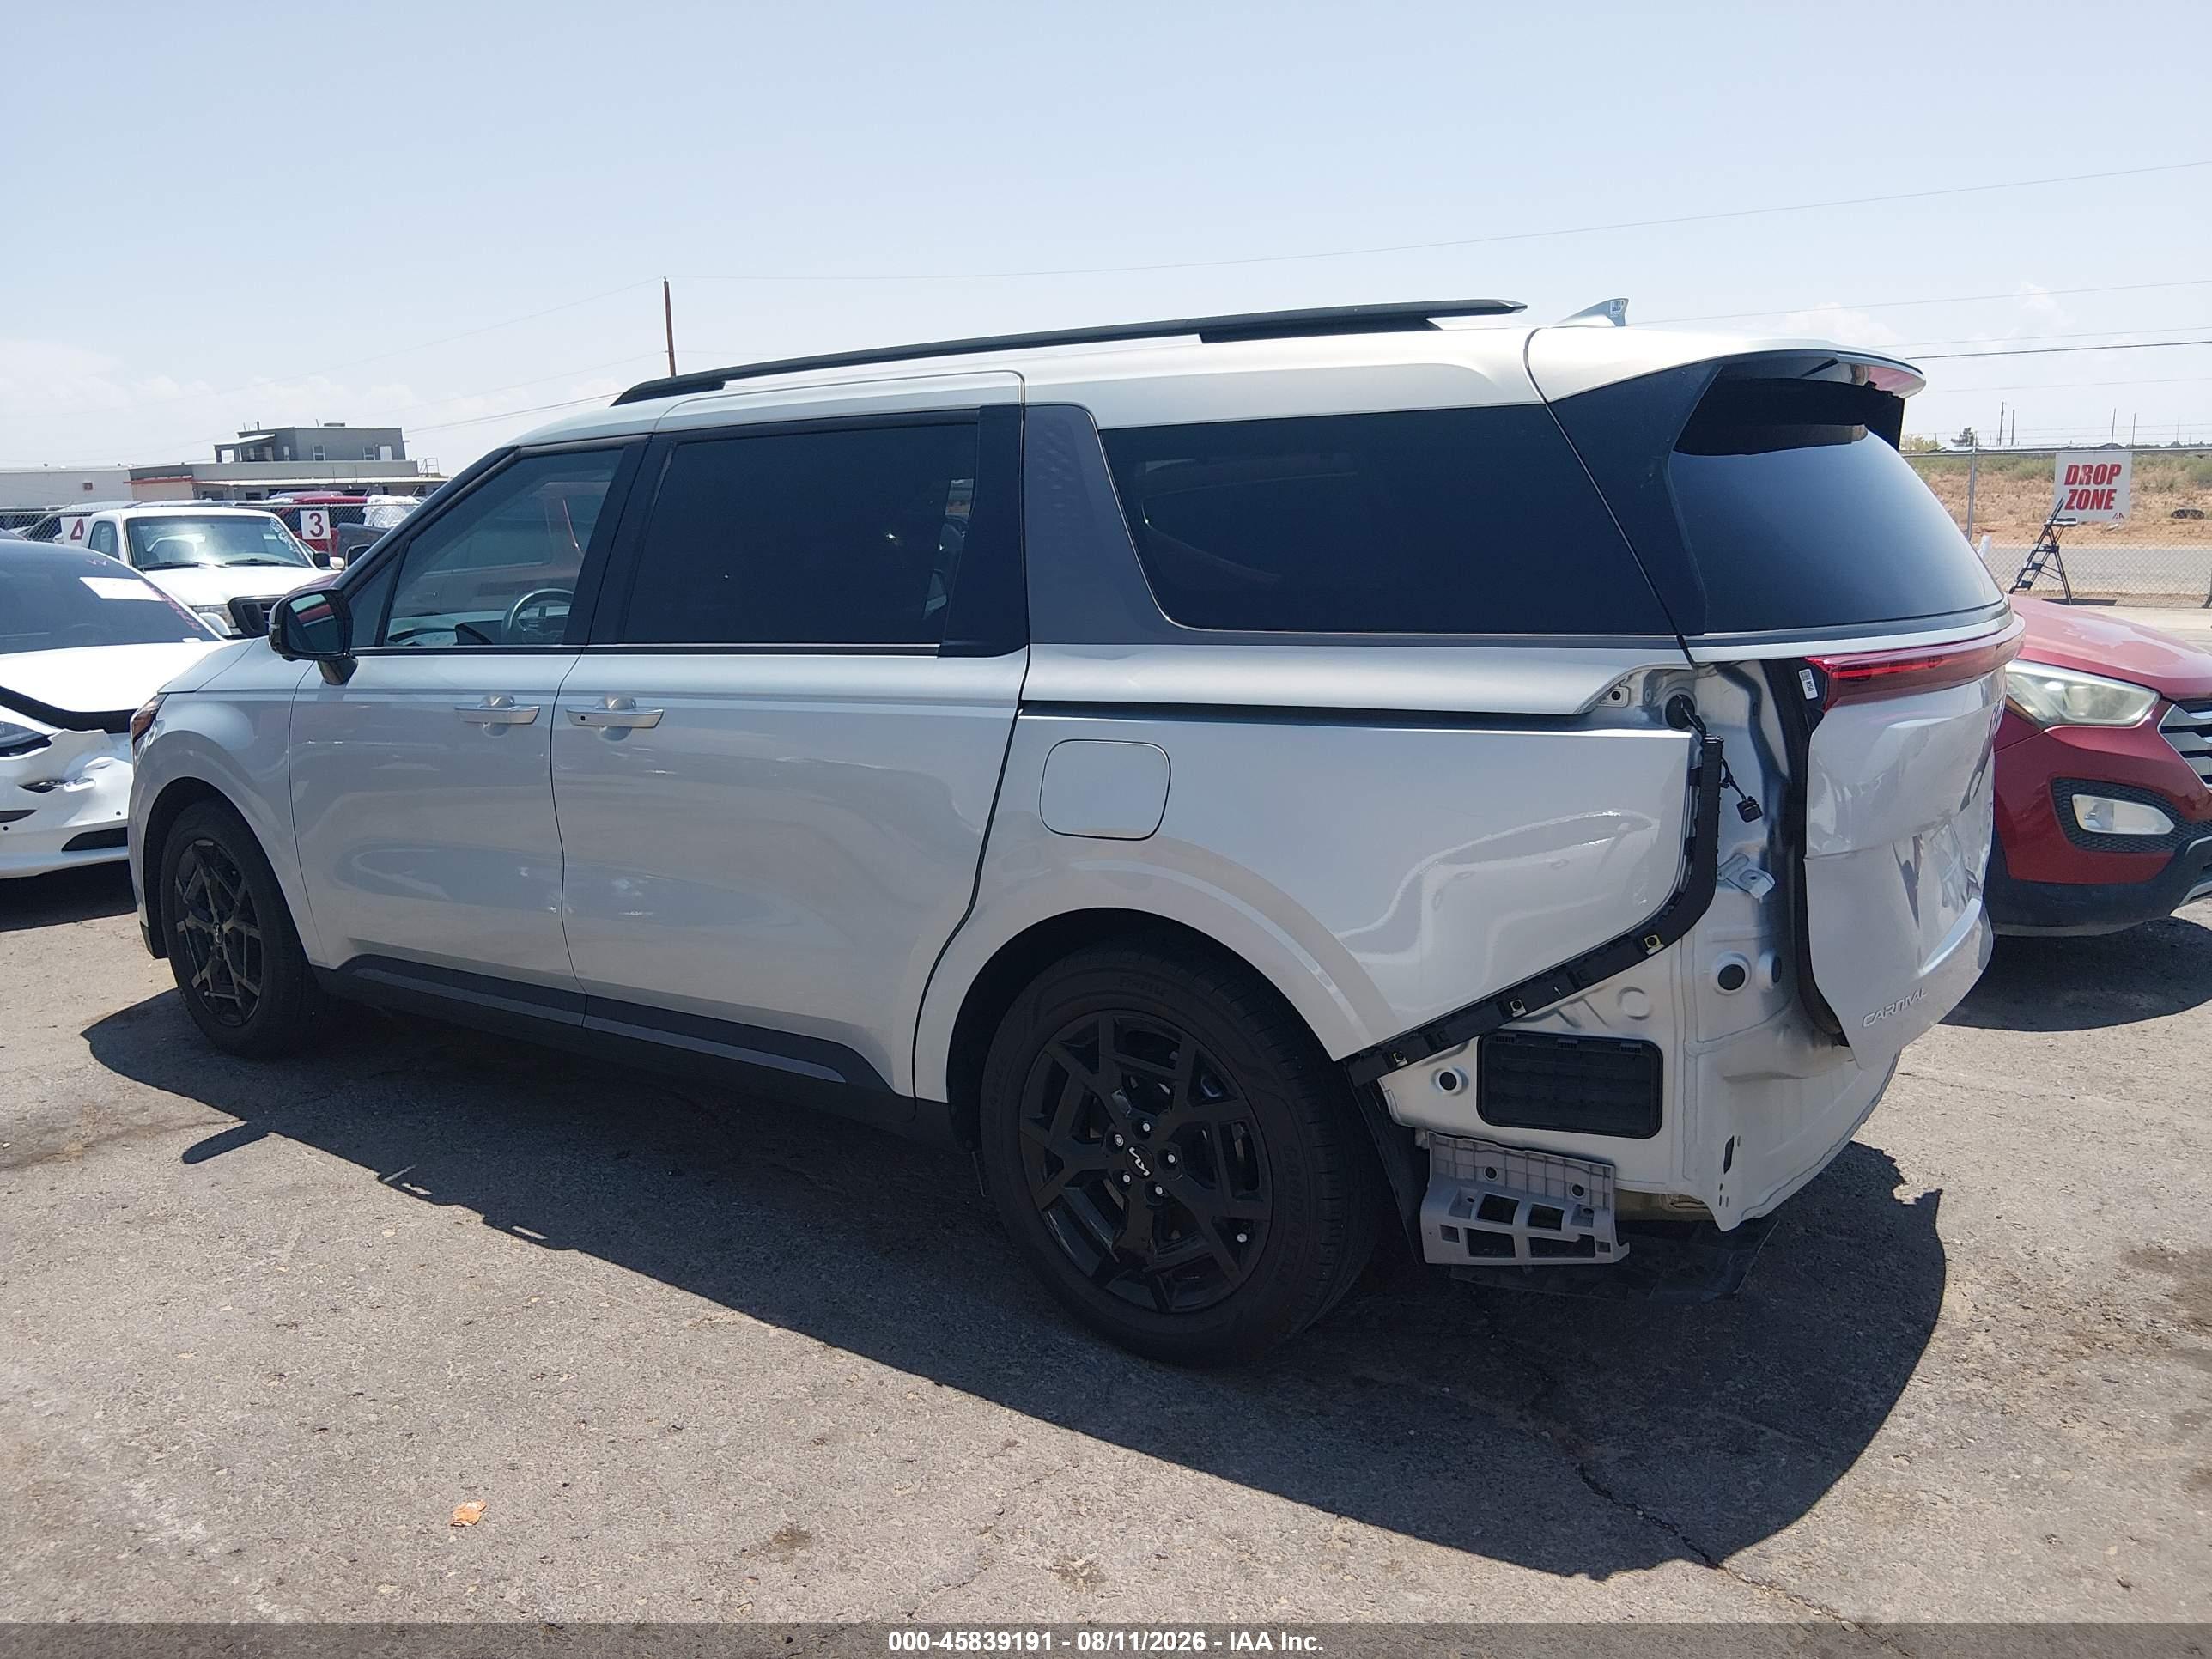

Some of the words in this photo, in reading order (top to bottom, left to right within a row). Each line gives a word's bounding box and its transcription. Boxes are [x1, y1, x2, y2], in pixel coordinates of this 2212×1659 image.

[2064, 464, 2122, 486] DROP
[2064, 489, 2118, 511] ZONE
[309, 512, 324, 538] 3
[1862, 988, 1929, 1028] CARNIVAL
